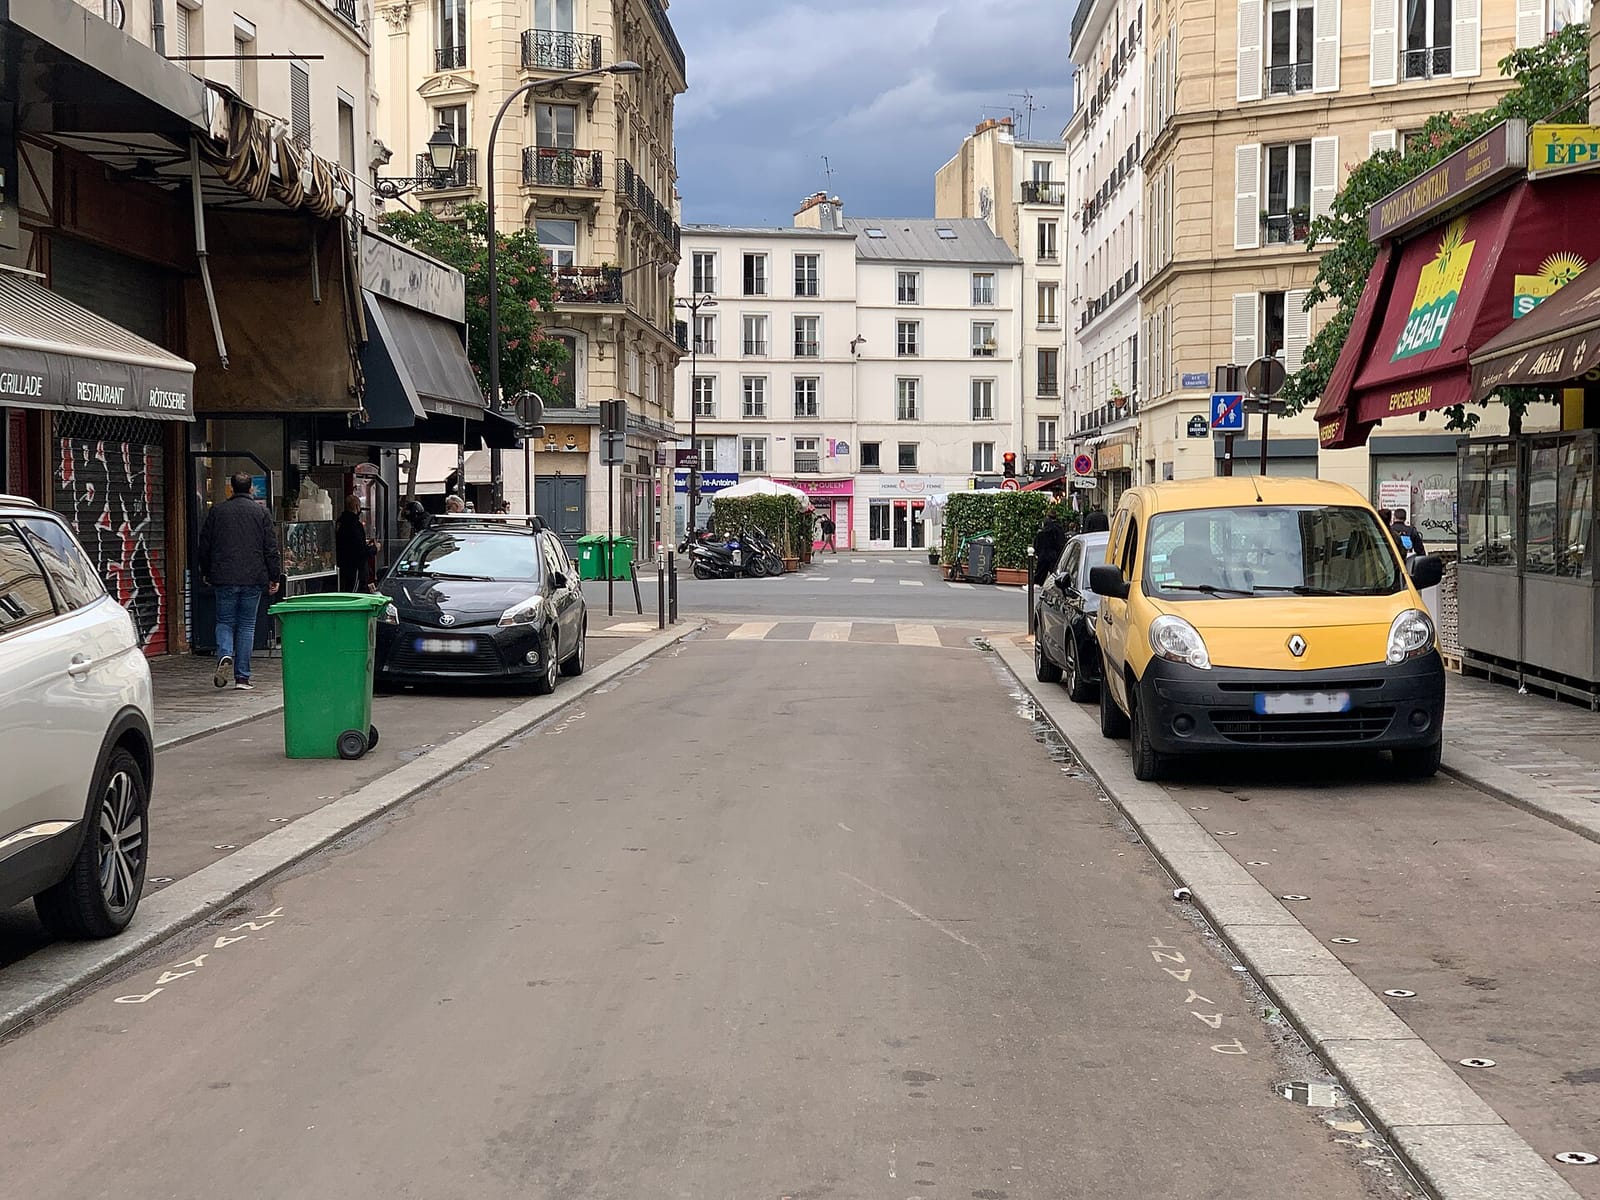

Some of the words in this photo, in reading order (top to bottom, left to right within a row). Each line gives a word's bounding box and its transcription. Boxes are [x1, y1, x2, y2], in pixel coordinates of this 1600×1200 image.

[1381, 189, 1411, 230] PRODUITS
[1412, 166, 1450, 213] ORIENTAUX
[1396, 302, 1454, 355] SABAH
[0, 373, 43, 397] GRILLADE
[77, 381, 125, 405] RESTAURANT
[149, 387, 186, 410] RÔTISSERIE
[1389, 390, 1414, 411] EPICERIE
[1413, 386, 1433, 407] SABAH
[113, 906, 284, 1003] PAYANT
[1147, 936, 1248, 1054] PAYANT
